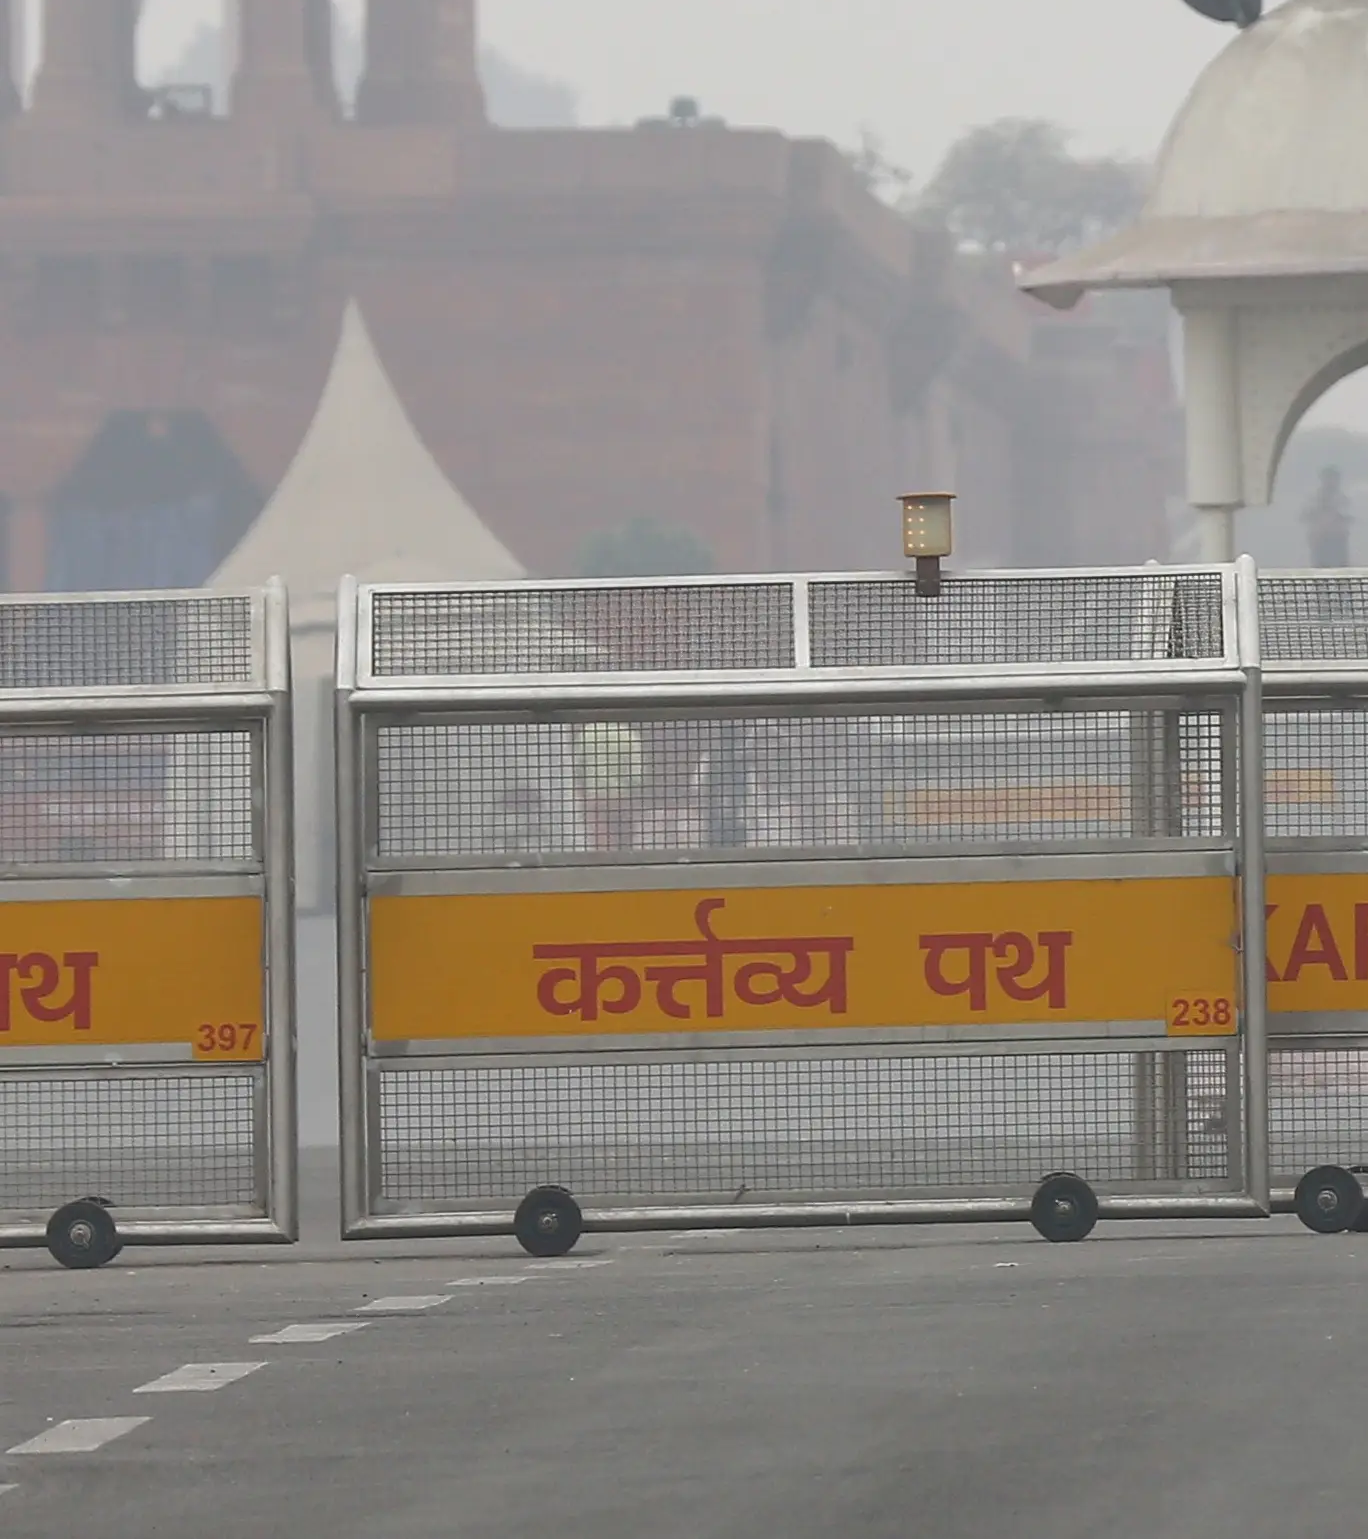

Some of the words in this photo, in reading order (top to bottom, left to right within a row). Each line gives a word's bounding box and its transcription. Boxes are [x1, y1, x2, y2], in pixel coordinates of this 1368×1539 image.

[0, 951, 99, 1032] थ
[919, 930, 1073, 1011] पथ
[197, 1024, 258, 1052] 397
[1172, 998, 1231, 1027] 238
